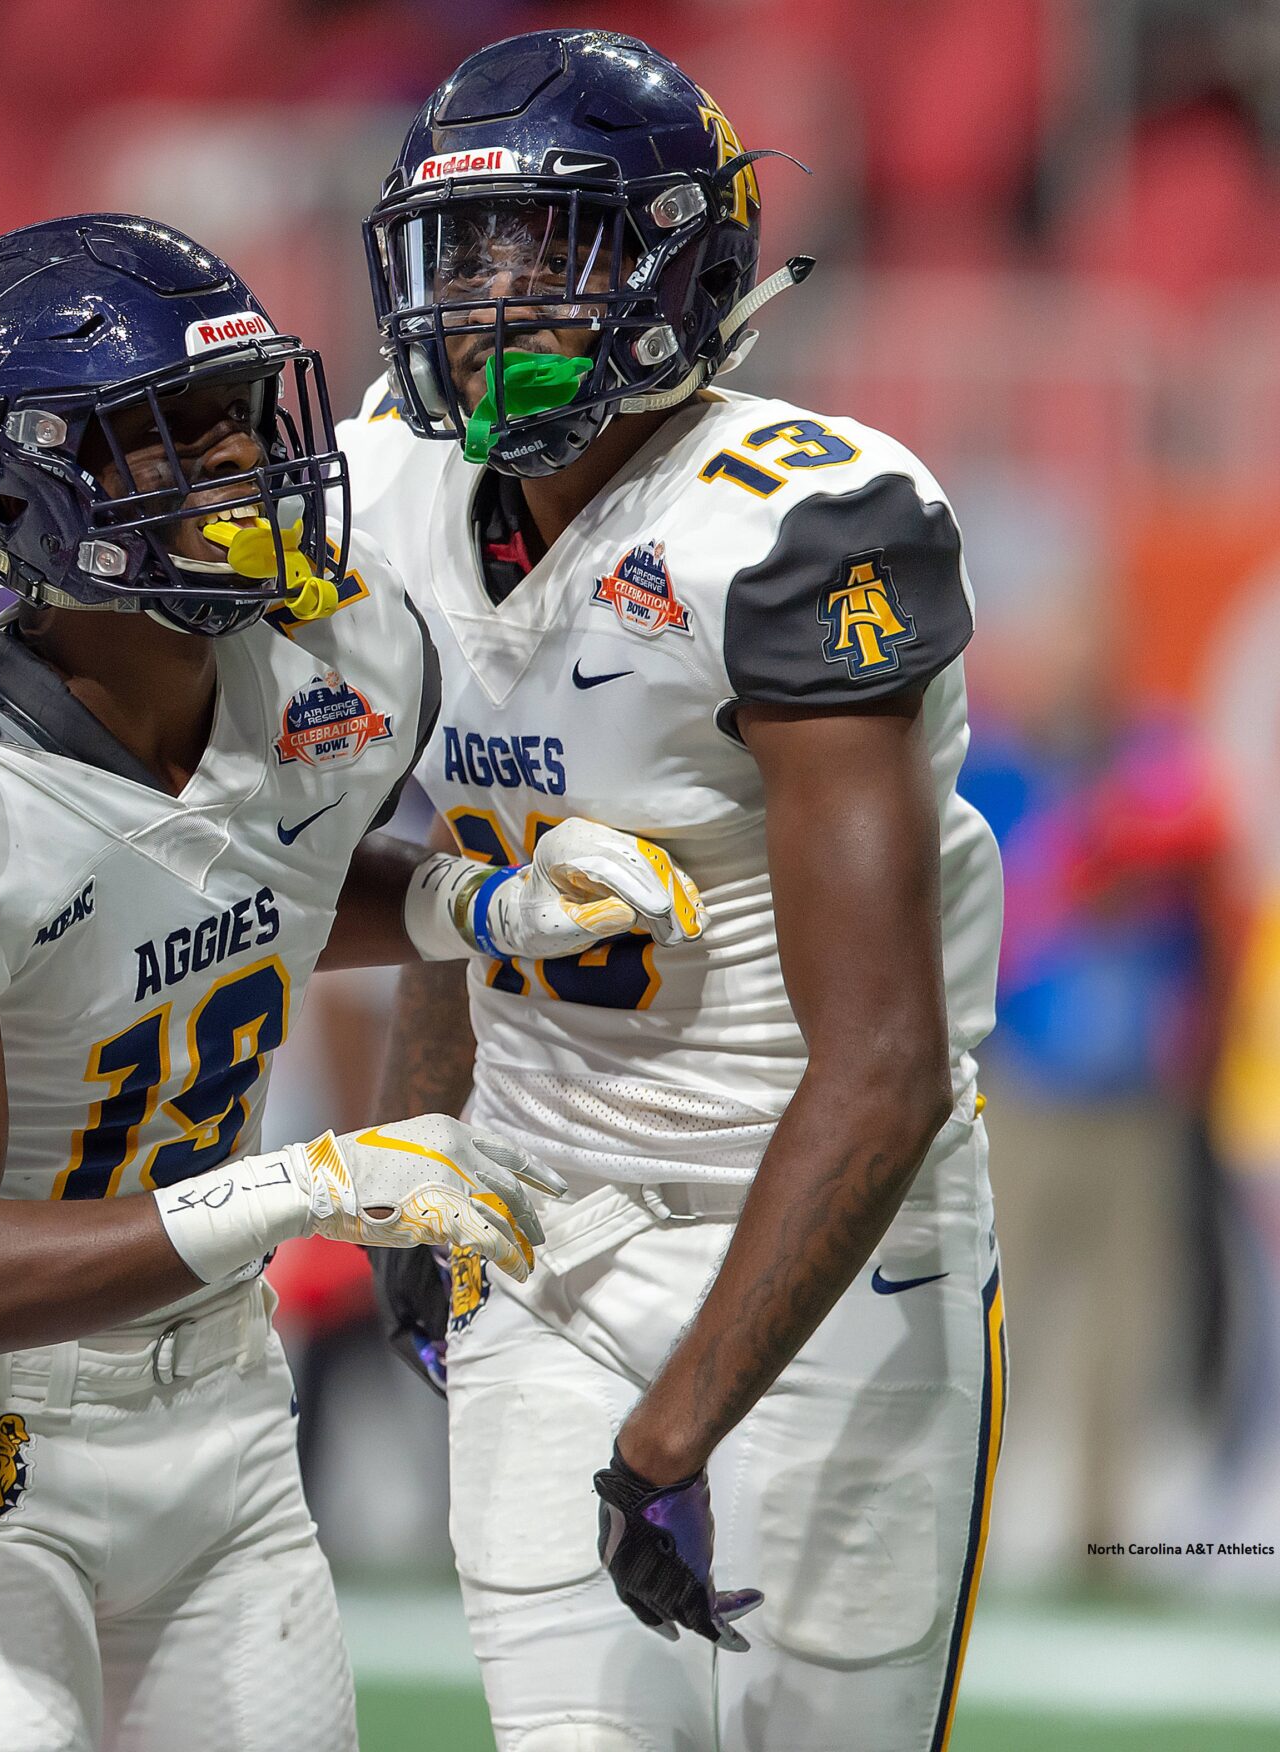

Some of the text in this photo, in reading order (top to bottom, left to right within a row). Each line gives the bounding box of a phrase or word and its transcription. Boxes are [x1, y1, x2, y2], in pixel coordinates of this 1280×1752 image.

[422, 151, 503, 180] Riddell
[198, 315, 267, 345] Riddell
[501, 440, 546, 461] Riddell
[697, 419, 863, 500] 13
[631, 566, 666, 587] AIR FORCE
[632, 575, 663, 594] RESERVE
[614, 581, 671, 612] CELEBRATION
[626, 601, 651, 620] BOWL
[303, 698, 359, 719] AIR FORCE
[307, 706, 358, 726] RESERVE
[290, 716, 369, 747] CELEBRATION
[315, 737, 350, 756] BOWL
[442, 726, 567, 796] AGGIES
[31, 880, 95, 948] MEAC
[134, 886, 280, 1003] AGGIES
